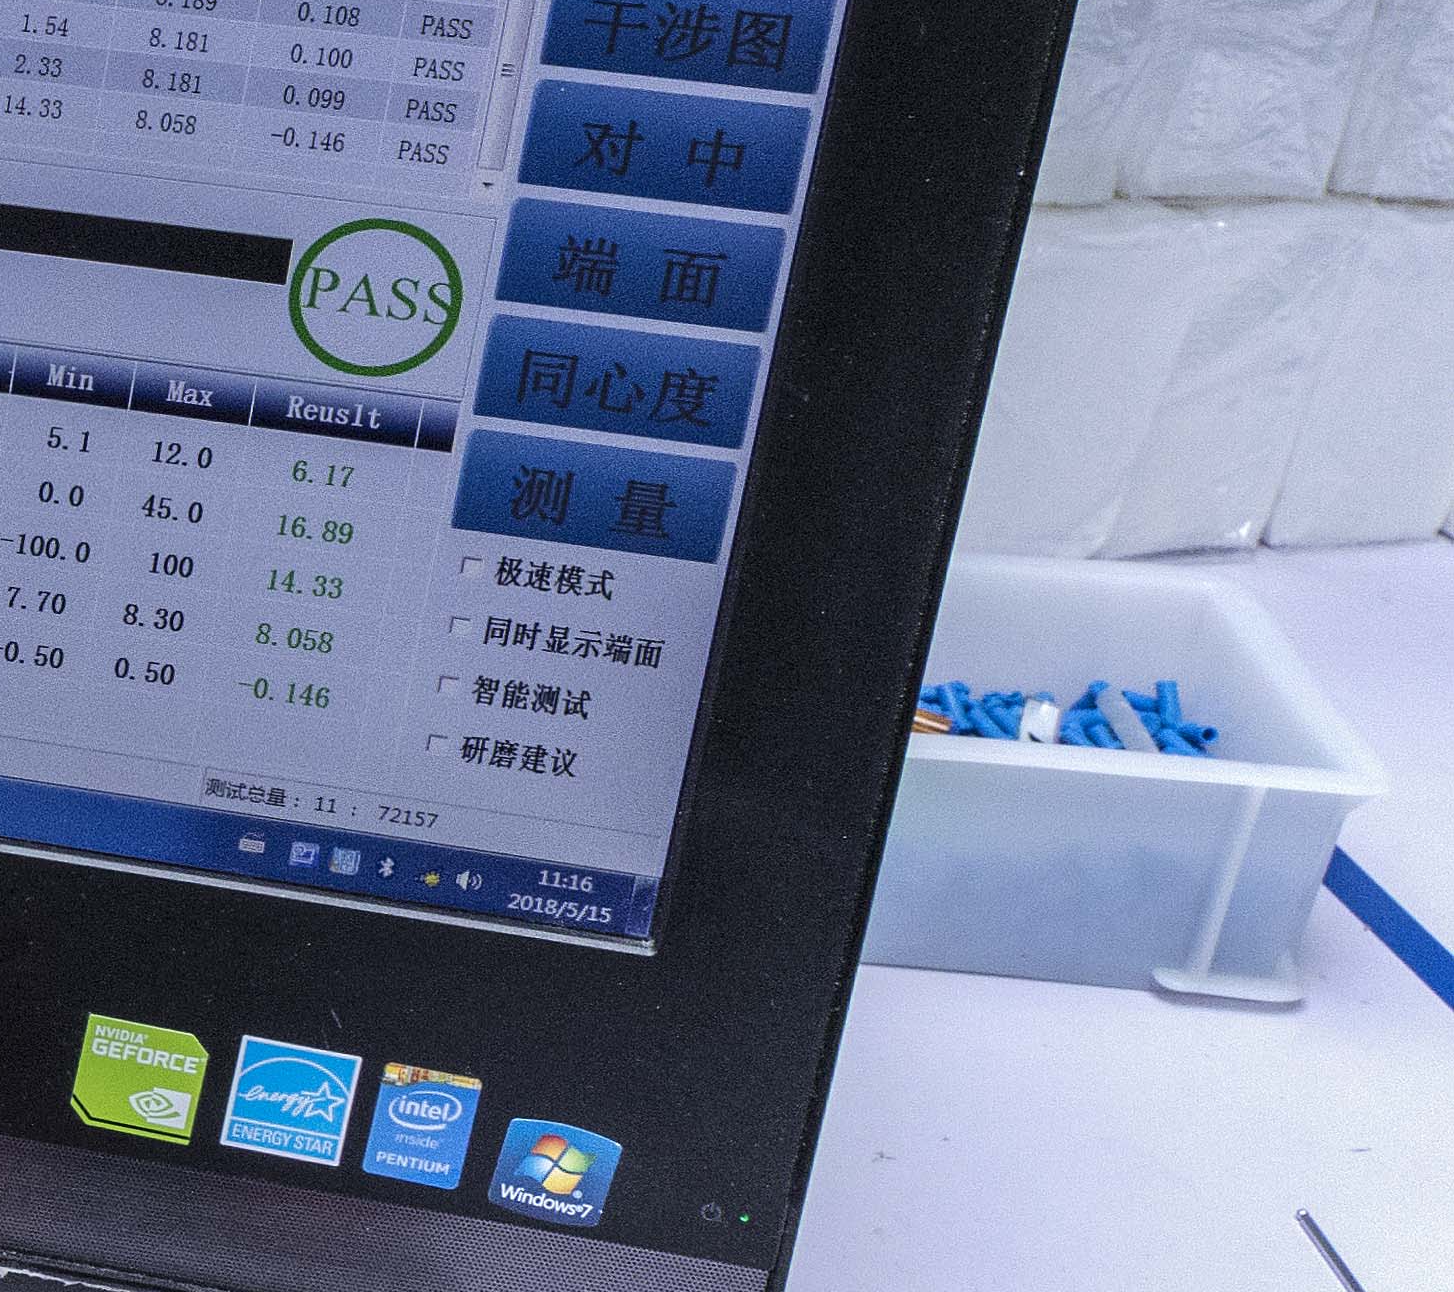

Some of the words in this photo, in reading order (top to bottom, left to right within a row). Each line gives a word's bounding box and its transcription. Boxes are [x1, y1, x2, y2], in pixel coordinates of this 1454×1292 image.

[585, 1, 798, 74] 干涉图
[14, 54, 62, 78] 2.33
[142, 69, 200, 94] 8.181
[283, 85, 345, 110] 0.099
[406, 98, 457, 122] PASS
[4, 95, 63, 119] 14.33
[136, 110, 196, 135] 8.058
[271, 127, 345, 152] -0.146
[398, 140, 449, 164] PASS
[305, 265, 459, 328] PASS
[48, 364, 95, 395] Min
[167, 380, 213, 409] Max
[286, 395, 382, 430] Reuslt
[516, 350, 717, 428] 同心度
[47, 427, 89, 452] 5.1
[153, 442, 212, 468] 12.0
[292, 460, 354, 487] 6.17
[39, 482, 84, 507] 0.0
[142, 495, 203, 523] 45.0
[278, 515, 353, 544] 16.89
[2, 534, 90, 563] -100.0
[151, 553, 193, 577] 100
[268, 570, 343, 599] 14.33
[497, 556, 614, 600] 极速模式
[8, 587, 66, 614] 7.70
[123, 604, 184, 631] 8.30
[256, 623, 333, 653] 8.058
[484, 616, 665, 668] 同时显示端面
[114, 658, 175, 685] 0.50
[240, 678, 330, 708] -0.146
[473, 676, 591, 719] 智能测试
[462, 737, 577, 777] 研磨建议
[315, 797, 335, 813] 11
[379, 806, 438, 828] 72157
[539, 870, 592, 892] 11:16
[508, 894, 611, 923] 2018/5/15
[231, 1123, 288, 1151] ENERGY
[295, 1136, 332, 1153] STAR
[394, 1101, 449, 1124] intel
[377, 1151, 450, 1174] PENTIUM
